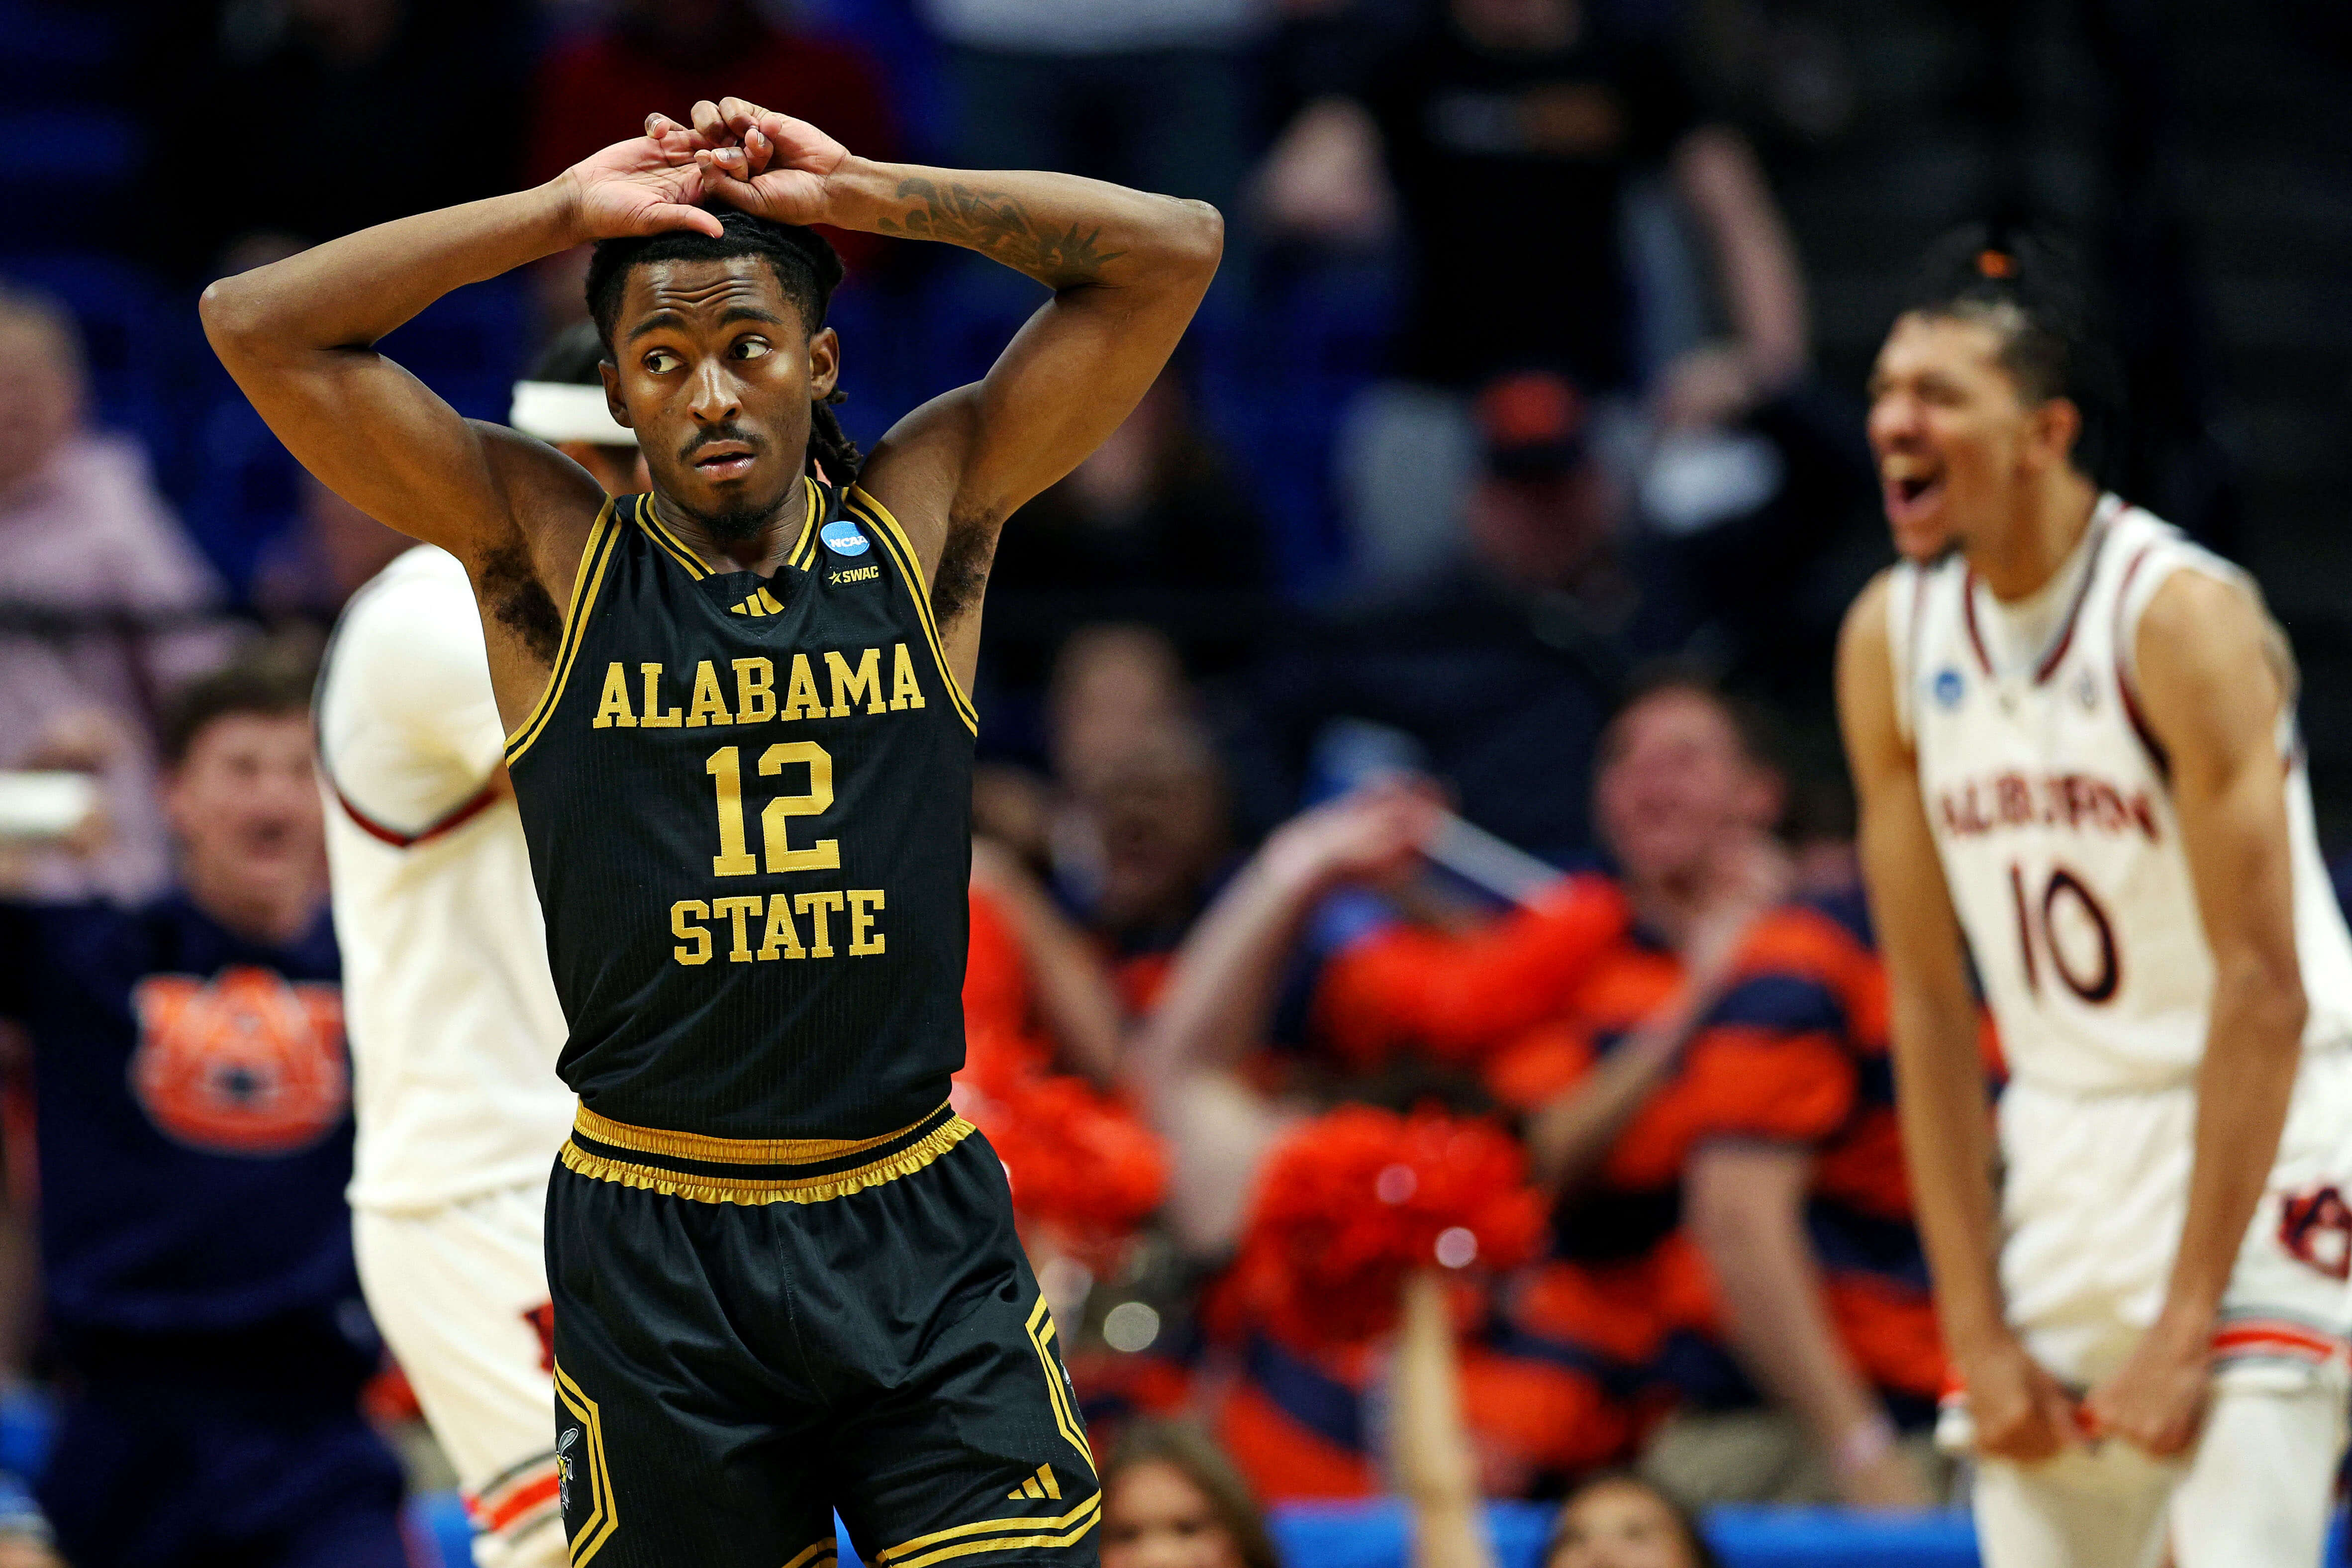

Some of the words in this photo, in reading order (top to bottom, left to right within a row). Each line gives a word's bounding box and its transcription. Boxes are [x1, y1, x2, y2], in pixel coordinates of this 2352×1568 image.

[829, 535, 869, 548] NCAA
[842, 566, 879, 583] SWAC
[593, 643, 925, 728] ALABAMA
[706, 741, 840, 877] 12
[671, 889, 885, 965] STATE
[2008, 857, 2121, 1005] 10
